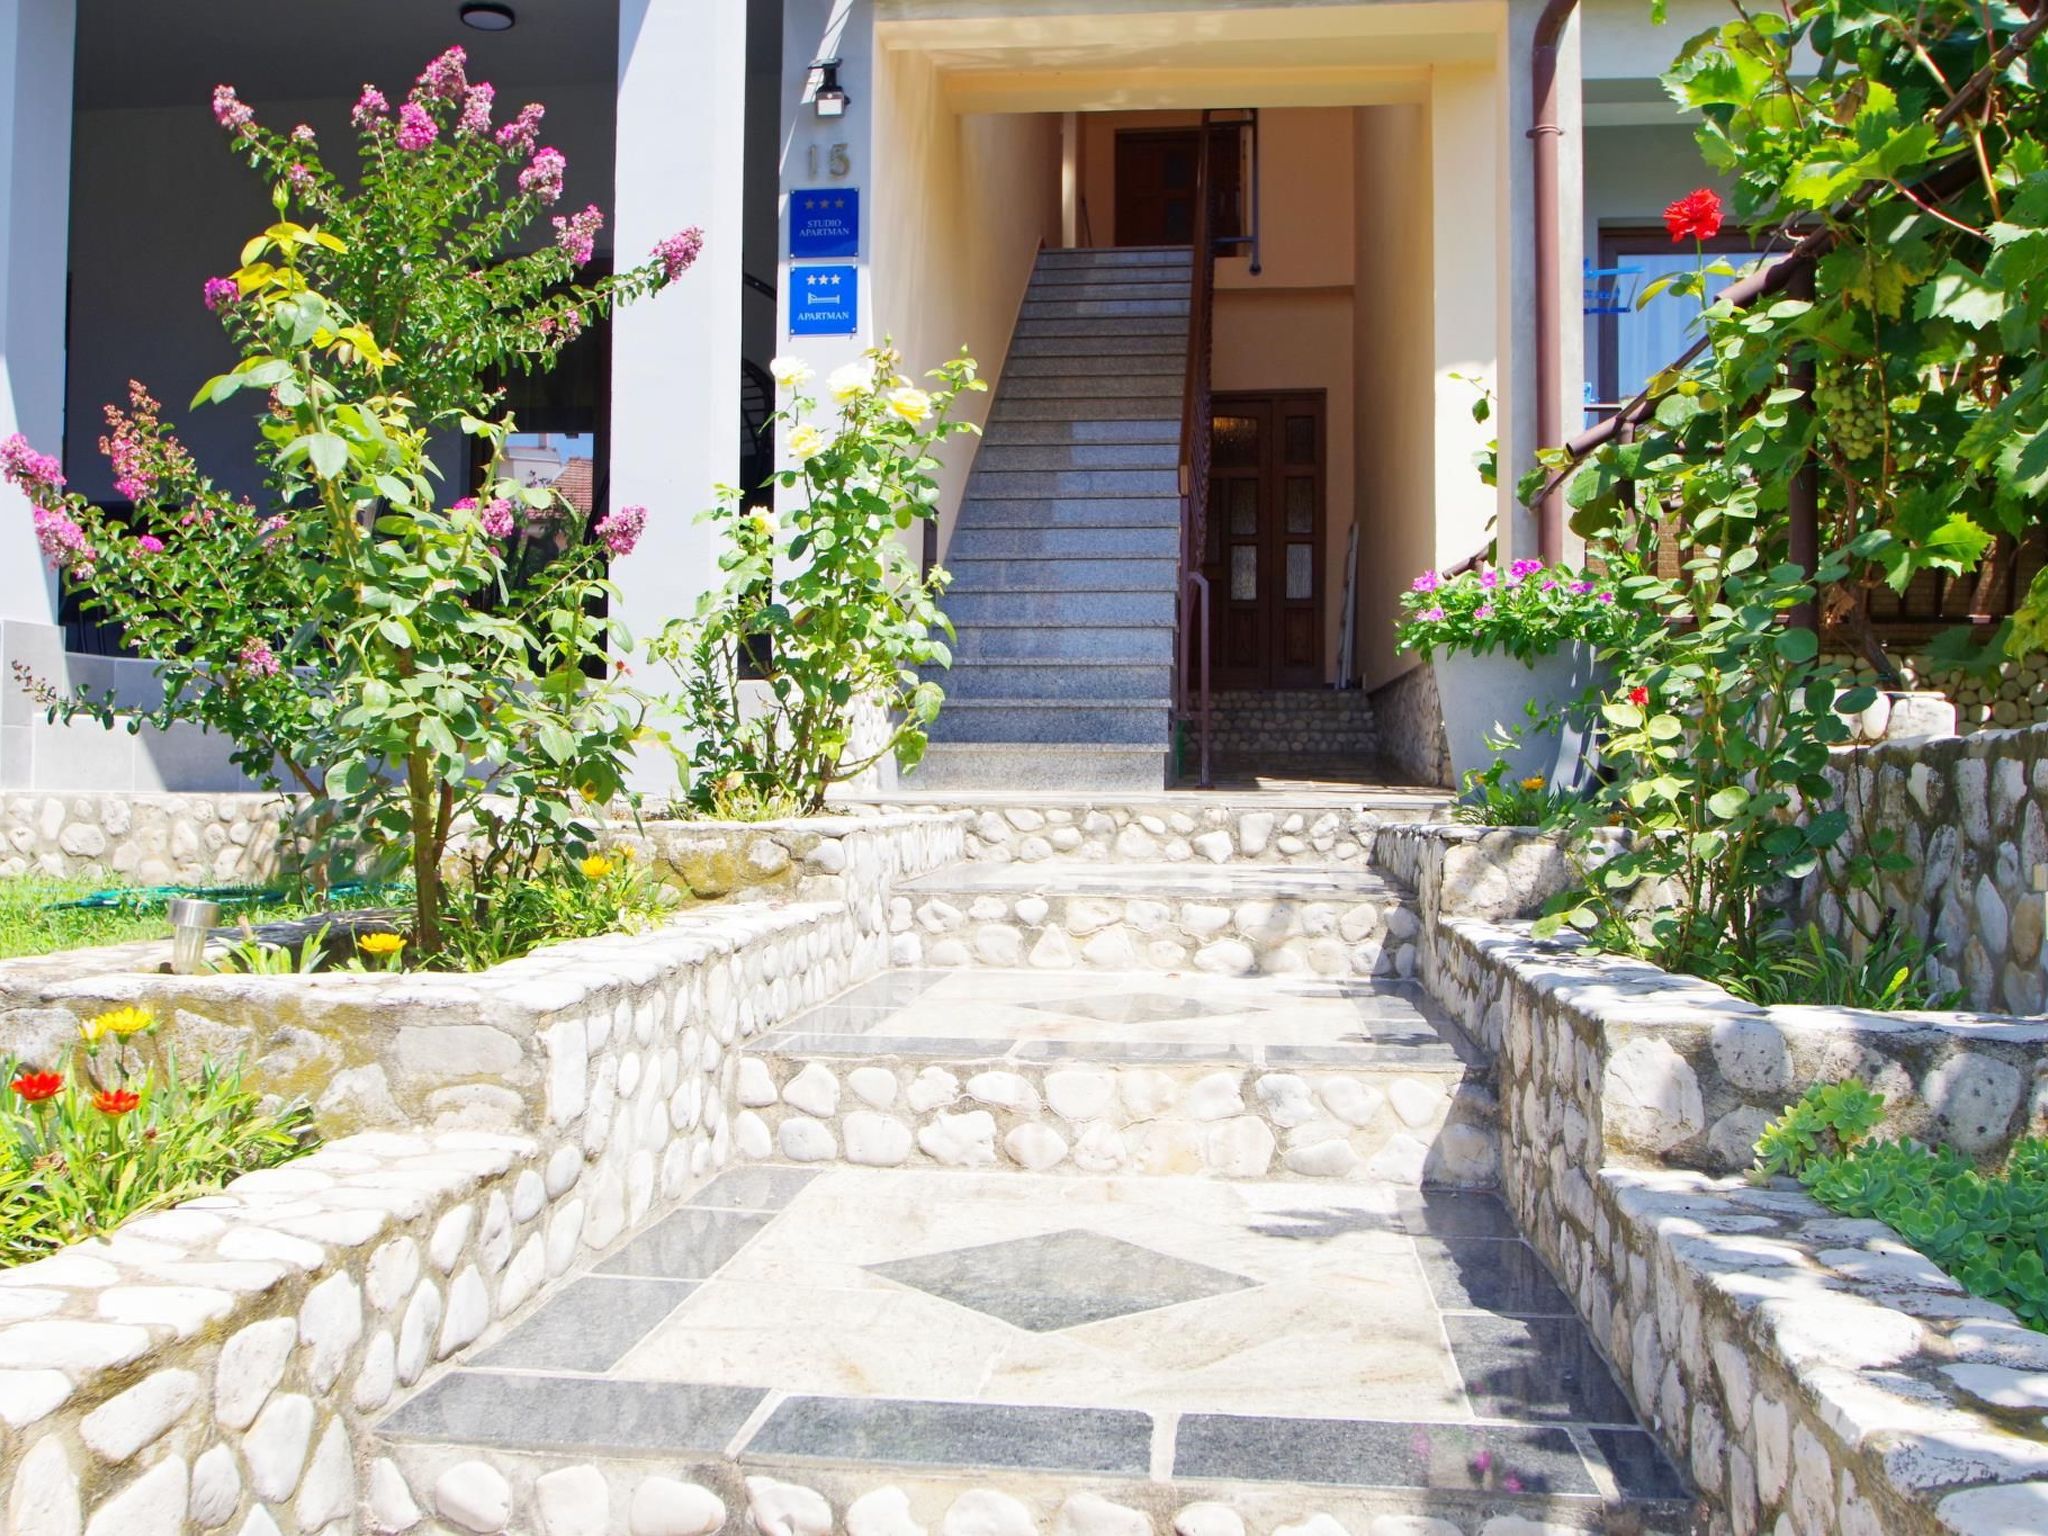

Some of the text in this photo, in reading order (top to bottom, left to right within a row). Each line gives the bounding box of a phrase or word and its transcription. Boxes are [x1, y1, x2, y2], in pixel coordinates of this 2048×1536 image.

[807, 143, 850, 179] 15
[807, 218, 842, 228] STUDIO
[799, 227, 850, 238] APARTMAN
[797, 310, 850, 321] APARTMAN
